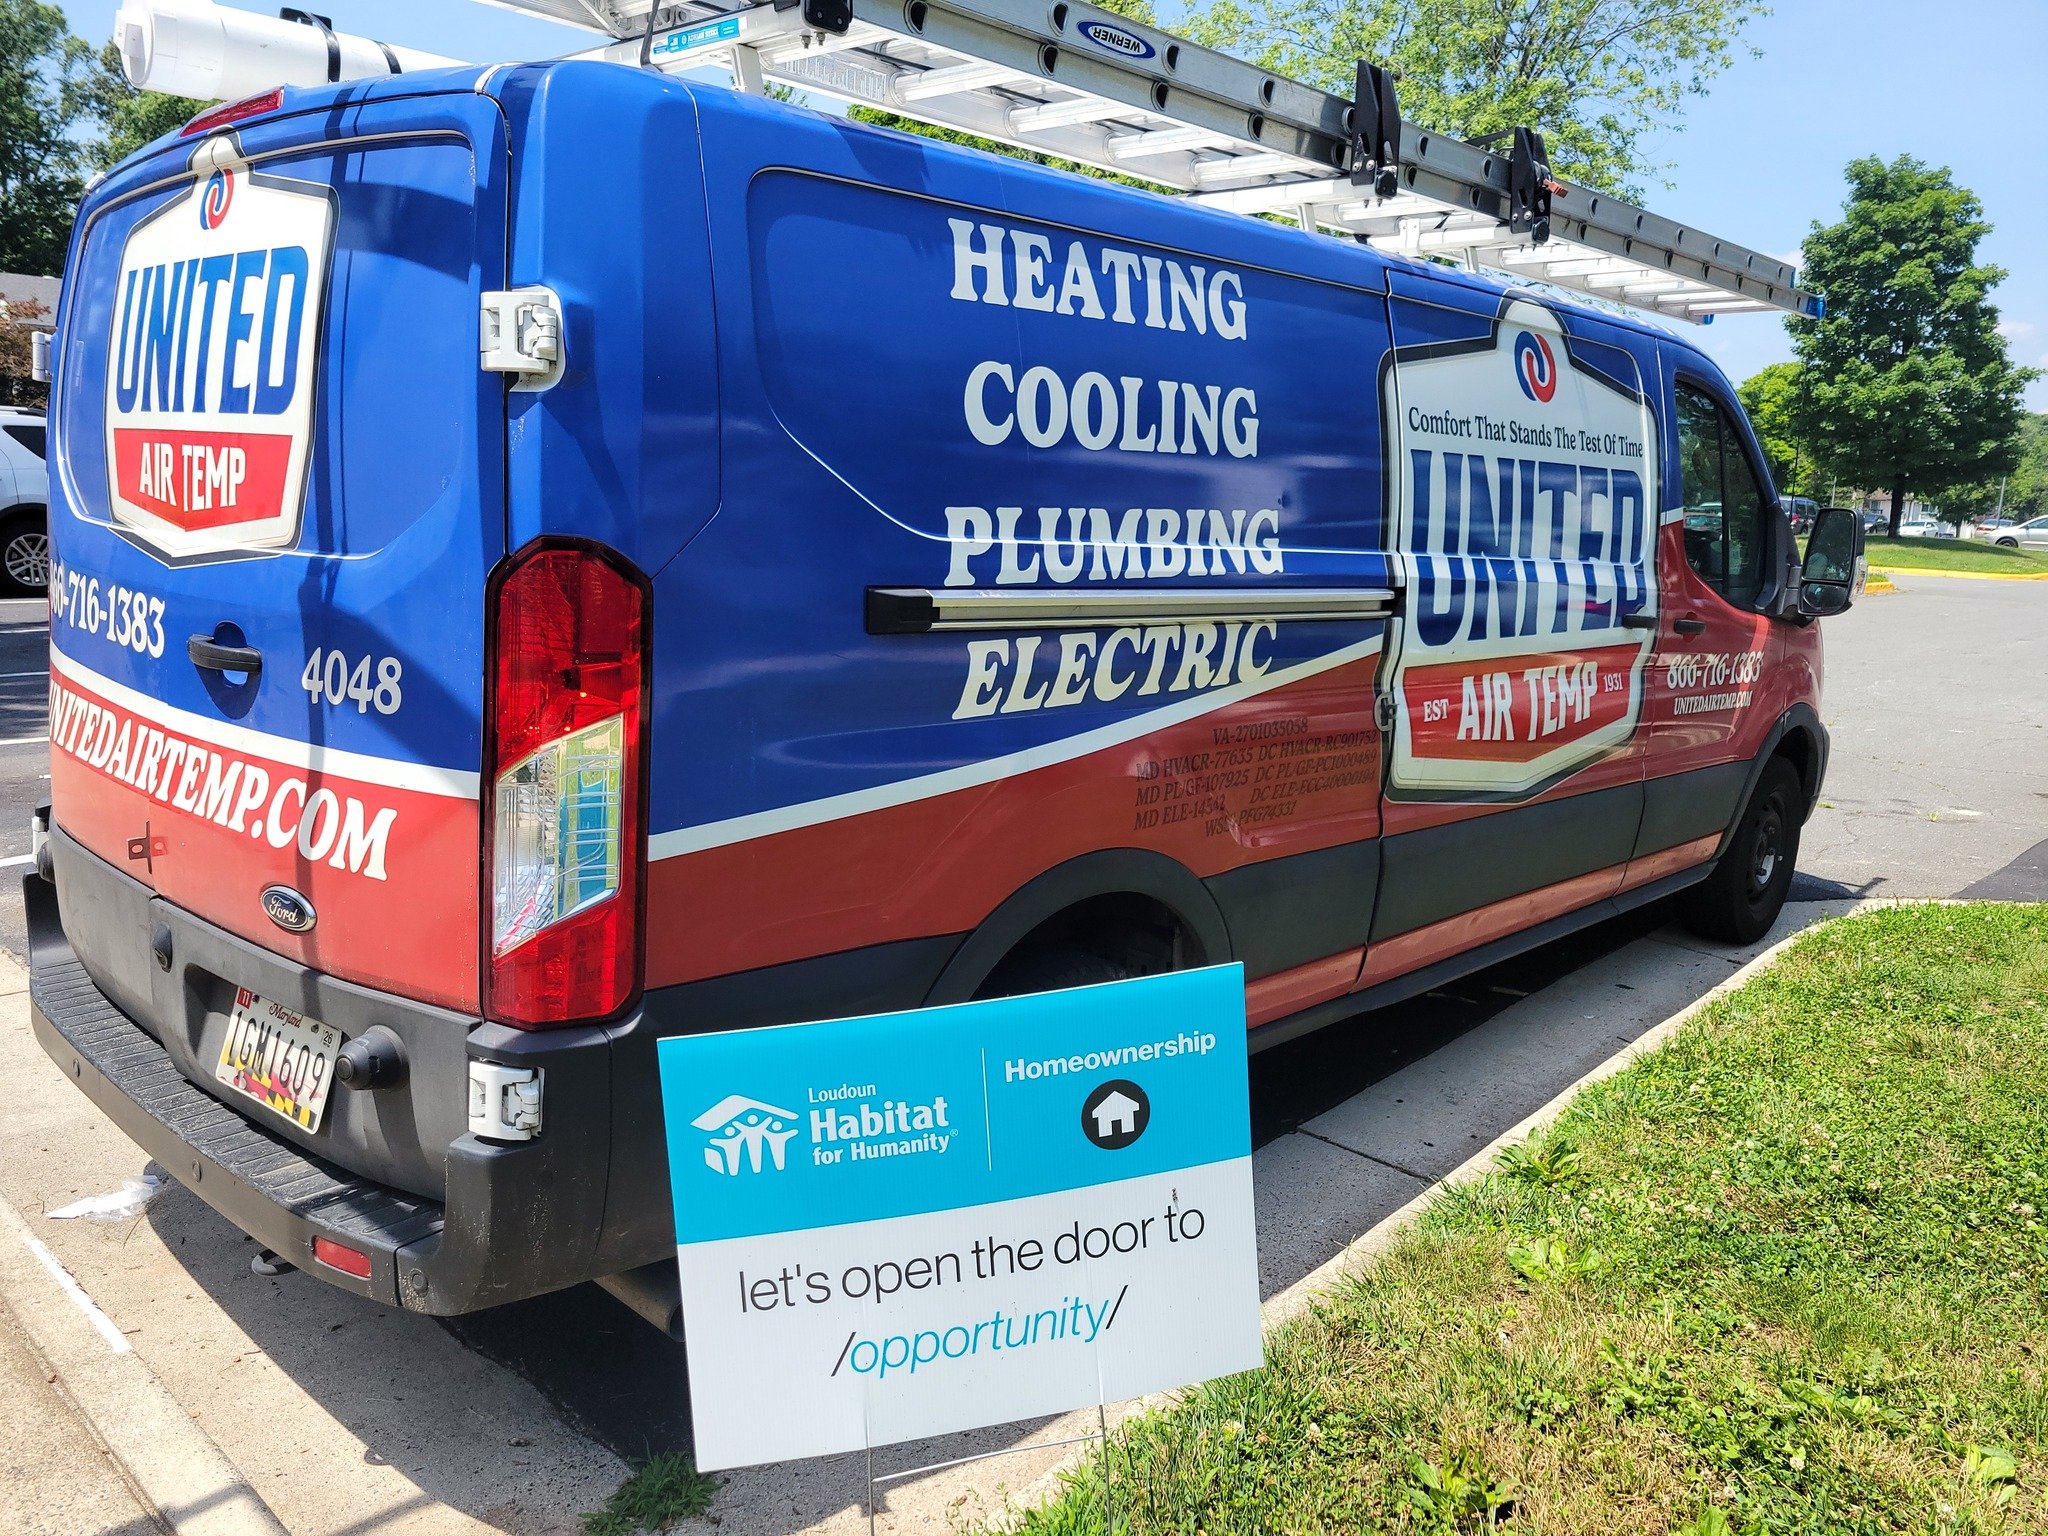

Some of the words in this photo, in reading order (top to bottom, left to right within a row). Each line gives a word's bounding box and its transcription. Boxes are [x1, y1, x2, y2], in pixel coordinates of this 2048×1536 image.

[1092, 27, 1141, 53] WERNER
[947, 217, 1247, 341] HEATING
[116, 245, 310, 415] UNITED
[964, 361, 1259, 458] COOLING
[1408, 406, 1472, 438] Comfort
[1474, 415, 1506, 442] That
[1509, 420, 1552, 448] Stands
[1554, 426, 1576, 450] The
[1578, 430, 1601, 454] Test
[1603, 432, 1617, 455] Of
[1618, 435, 1643, 458] Time
[139, 440, 175, 505] AIR
[181, 444, 246, 513] TEMP
[944, 506, 1284, 587] PLUMBING
[1410, 449, 1648, 647] UNITED
[302, 646, 402, 715] 4048
[951, 619, 1278, 721] ELECTRIC
[1667, 651, 1765, 690] 866-716-1383
[1423, 698, 1449, 723] EST
[1456, 671, 1515, 741] AIR
[1523, 661, 1599, 742] TEMP
[1603, 673, 1624, 693] 1931
[1673, 690, 1753, 716] UNITEDAIRTEMP.COM
[1212, 718, 1309, 746] VA-2701035058
[1134, 783, 1160, 807] MD
[1254, 764, 1275, 784] DC
[1136, 761, 1160, 782] MD
[1163, 747, 1254, 778] HVACR-77635
[1257, 742, 1278, 762] DC
[1133, 810, 1160, 831] MD
[1250, 786, 1273, 804] DC
[269, 895, 299, 923] Ford
[242, 990, 251, 1006] 11
[269, 1003, 303, 1029] Maryland
[1004, 1030, 1216, 1083] Homeownership
[808, 1083, 877, 1103] Loudoun
[809, 1096, 949, 1144] Habitat
[812, 1146, 844, 1166] for
[739, 1264, 831, 1313] let's
[842, 1252, 961, 1304] open
[970, 1236, 1044, 1279] the
[1053, 1221, 1155, 1265] door
[1163, 1205, 1205, 1243] to
[831, 1284, 1129, 1378] /opportunity/
